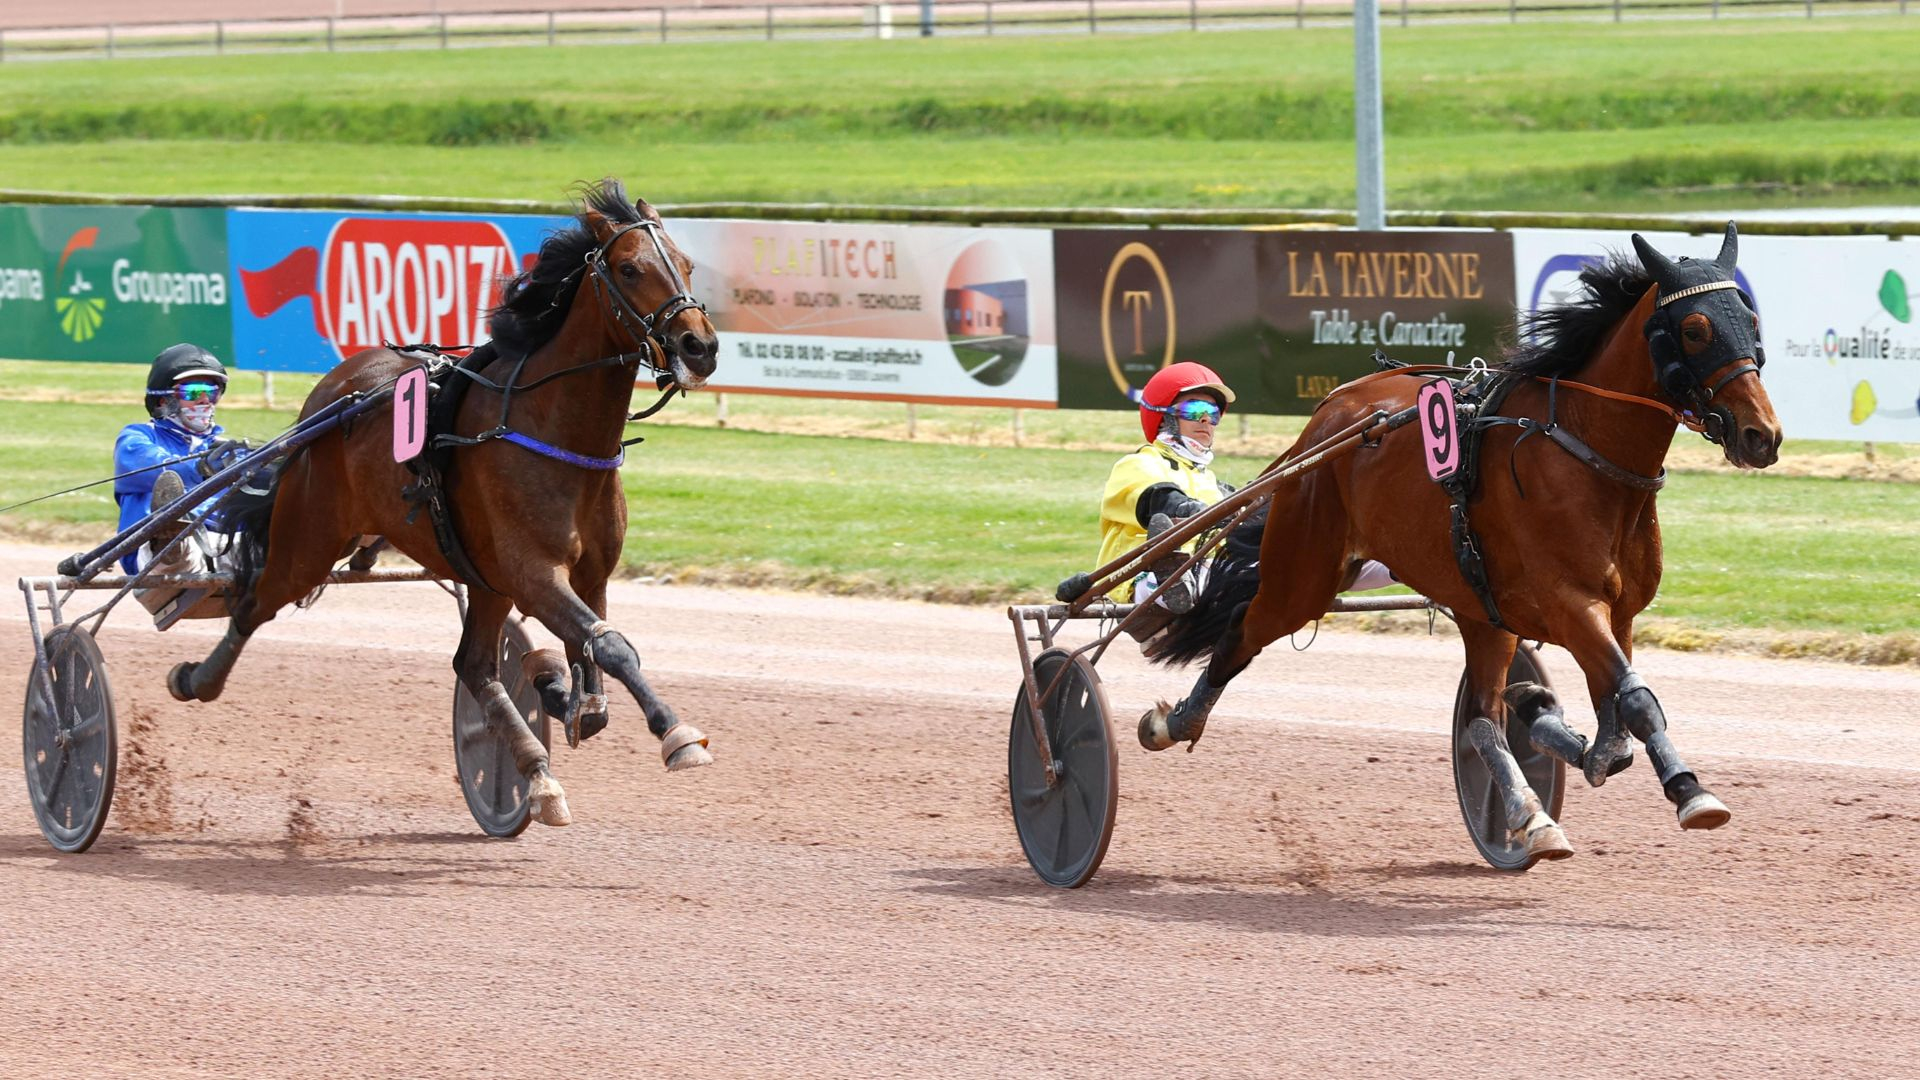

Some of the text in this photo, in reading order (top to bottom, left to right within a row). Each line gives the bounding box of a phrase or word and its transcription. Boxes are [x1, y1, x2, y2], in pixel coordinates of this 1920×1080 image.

[752, 237, 897, 279] PLAFITECH
[1287, 252, 1484, 299] LA TAVERNE
[112, 258, 226, 314] Groupama
[1123, 290, 1153, 355] T
[1310, 309, 1466, 347] Table de Caractère
[1785, 339, 1810, 358] Pour
[1813, 339, 1821, 358] la
[1824, 327, 1890, 366] Qualité
[1893, 340, 1906, 360] de
[403, 377, 416, 444] 1
[1428, 392, 1451, 464] 9
